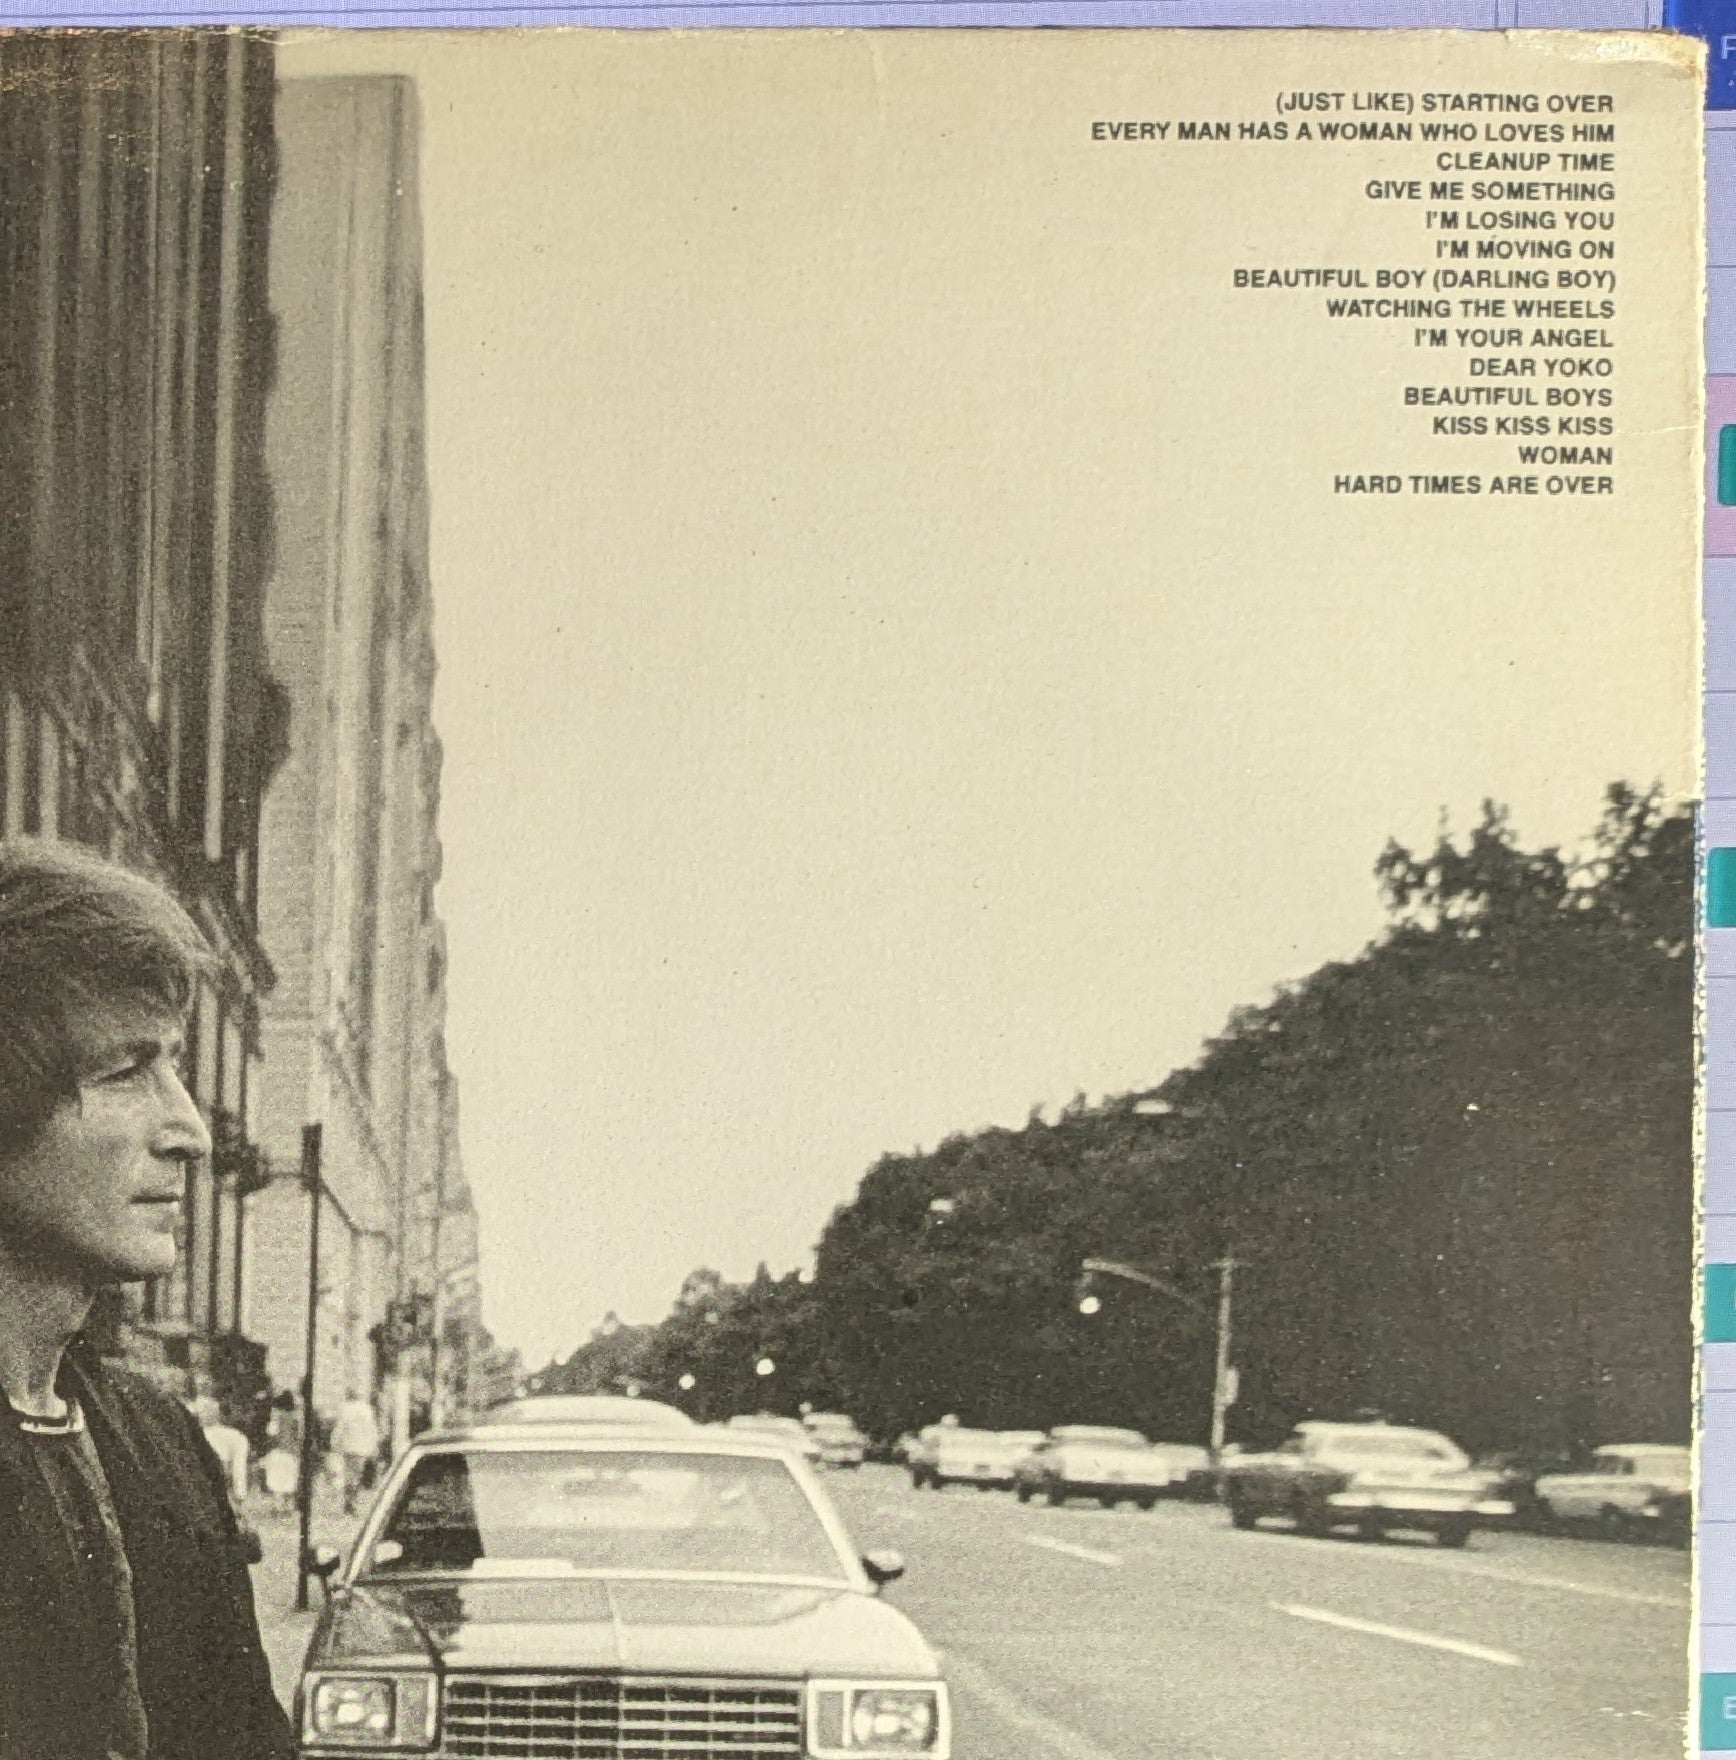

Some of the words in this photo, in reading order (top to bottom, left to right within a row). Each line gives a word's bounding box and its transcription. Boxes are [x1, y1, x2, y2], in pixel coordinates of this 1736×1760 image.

[1276, 92, 1346, 114] (JUST
[1352, 93, 1415, 115] LIKE)
[1421, 93, 1540, 112] STARTING
[1546, 94, 1614, 113] OVER
[1091, 121, 1171, 141] EVERY
[1177, 121, 1231, 141] MAN
[1237, 121, 1289, 141] HAS
[1295, 122, 1313, 141] A
[1318, 122, 1413, 141] WOMAN
[1419, 122, 1478, 142] WHO
[1484, 123, 1565, 143] LOVES
[1572, 123, 1615, 143] HIM
[1436, 152, 1551, 171] CLEANUP
[1557, 153, 1615, 171] TIME
[1365, 180, 1422, 200] GIVE
[1429, 182, 1464, 200] ME
[1471, 182, 1616, 201] SOMETHING
[1425, 210, 1459, 229] I'M
[1466, 211, 1557, 230] LOSING
[1564, 212, 1615, 231] YOU
[1436, 240, 1469, 258] I'M
[1476, 240, 1572, 260] MOVING
[1579, 241, 1615, 260] ON
[1233, 269, 1369, 289] BEAUTIFUL
[1376, 269, 1427, 289] BOY
[1432, 269, 1549, 292] (DARLING
[1557, 270, 1617, 293] BOY)
[1326, 299, 1452, 318] WATCHING
[1459, 299, 1506, 318] THE
[1513, 299, 1616, 319] WHEELS
[1414, 329, 1448, 347] I'M
[1455, 329, 1523, 348] YOUR
[1530, 329, 1614, 348] ANGEL
[1469, 358, 1536, 377] DEAR
[1543, 358, 1614, 377] YOKO
[1403, 387, 1539, 406] BEAUTIFUL
[1546, 387, 1613, 407] BOYS
[1432, 416, 1488, 435] KISS
[1495, 416, 1551, 436] KISS
[1558, 416, 1614, 436] KISS
[1518, 446, 1613, 465] WOMAN
[1333, 475, 1403, 494] HARD
[1408, 475, 1482, 494] TIMES
[1489, 475, 1539, 495] ARE
[1545, 476, 1614, 495] OVER
